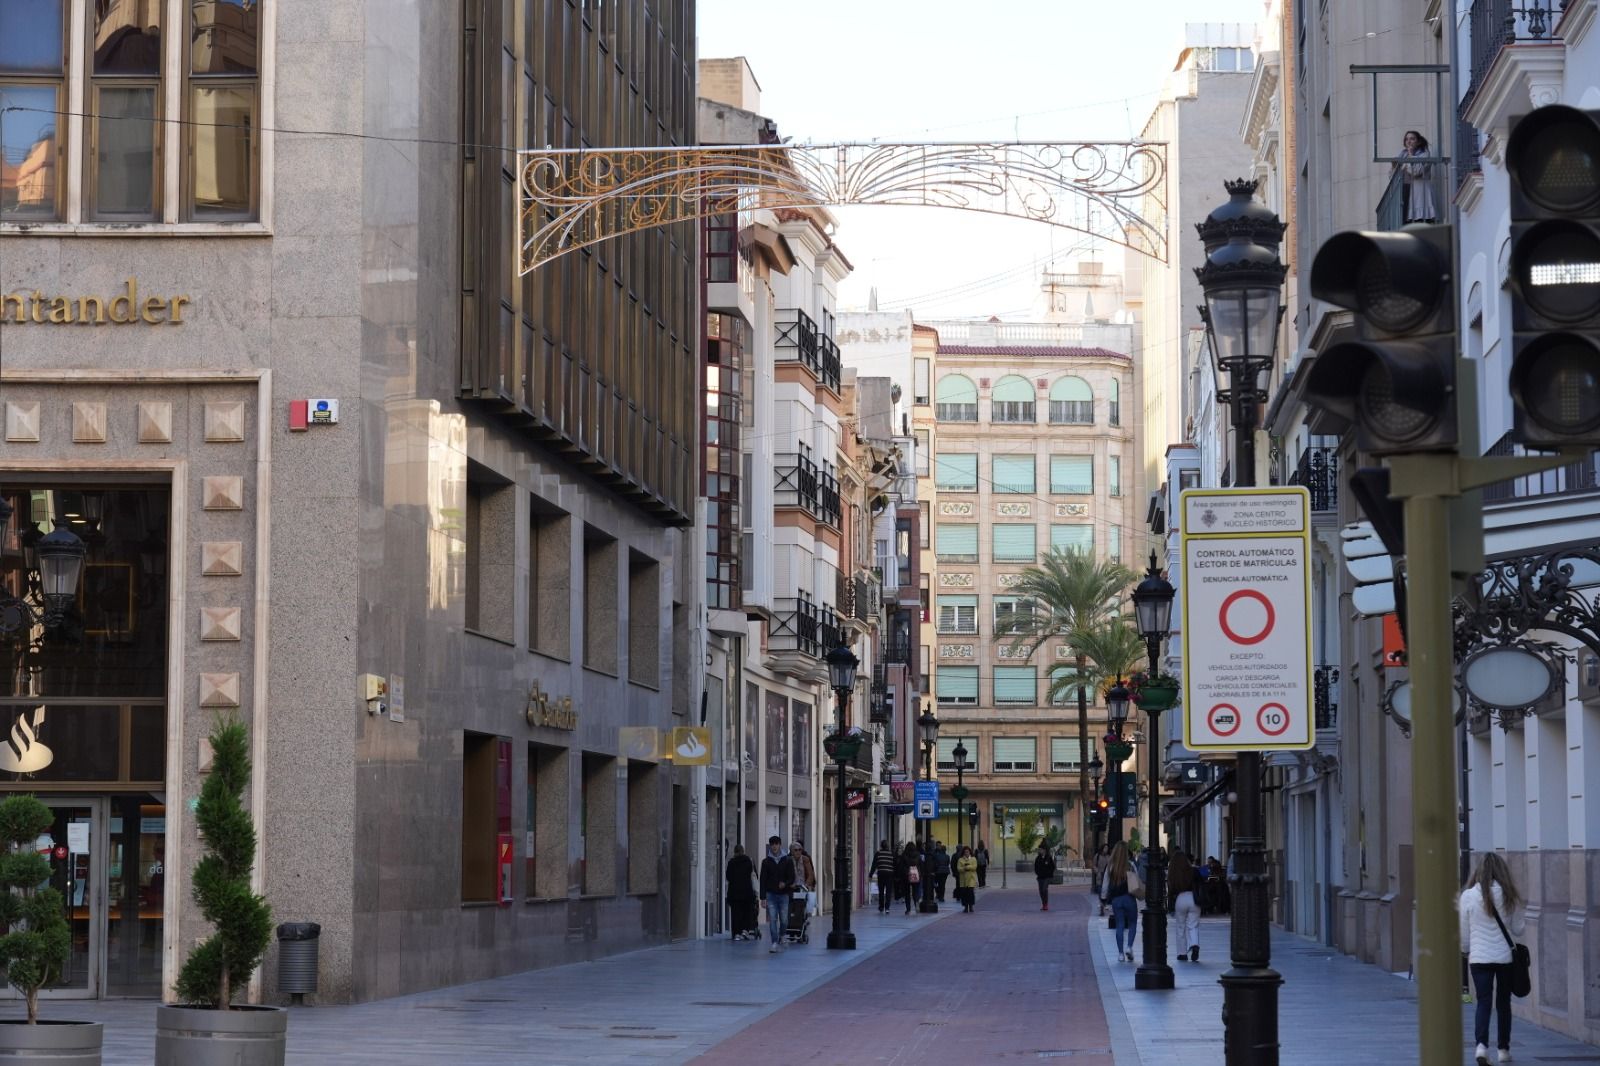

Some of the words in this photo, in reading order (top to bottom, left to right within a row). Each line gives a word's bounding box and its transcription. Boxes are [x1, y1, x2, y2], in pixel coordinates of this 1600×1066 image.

[1233, 511, 1254, 519] ZONA
[1255, 510, 1286, 518] CENTRO
[1223, 519, 1254, 528] NÚCLEO
[1255, 518, 1297, 527] HISTÓRICO
[1196, 549, 1237, 558] CONTROL
[1239, 547, 1295, 557] AUTOMÁTICO
[1194, 560, 1228, 568] LECTOR
[1229, 560, 1241, 568] DE
[1243, 558, 1297, 567] MATRÍCULAS
[1202, 575, 1240, 583] DENUNCIA
[1241, 573, 1288, 582] AUTOMÁTICA
[1230, 652, 1264, 660] EXCEPTO
[1265, 713, 1281, 725] 10
